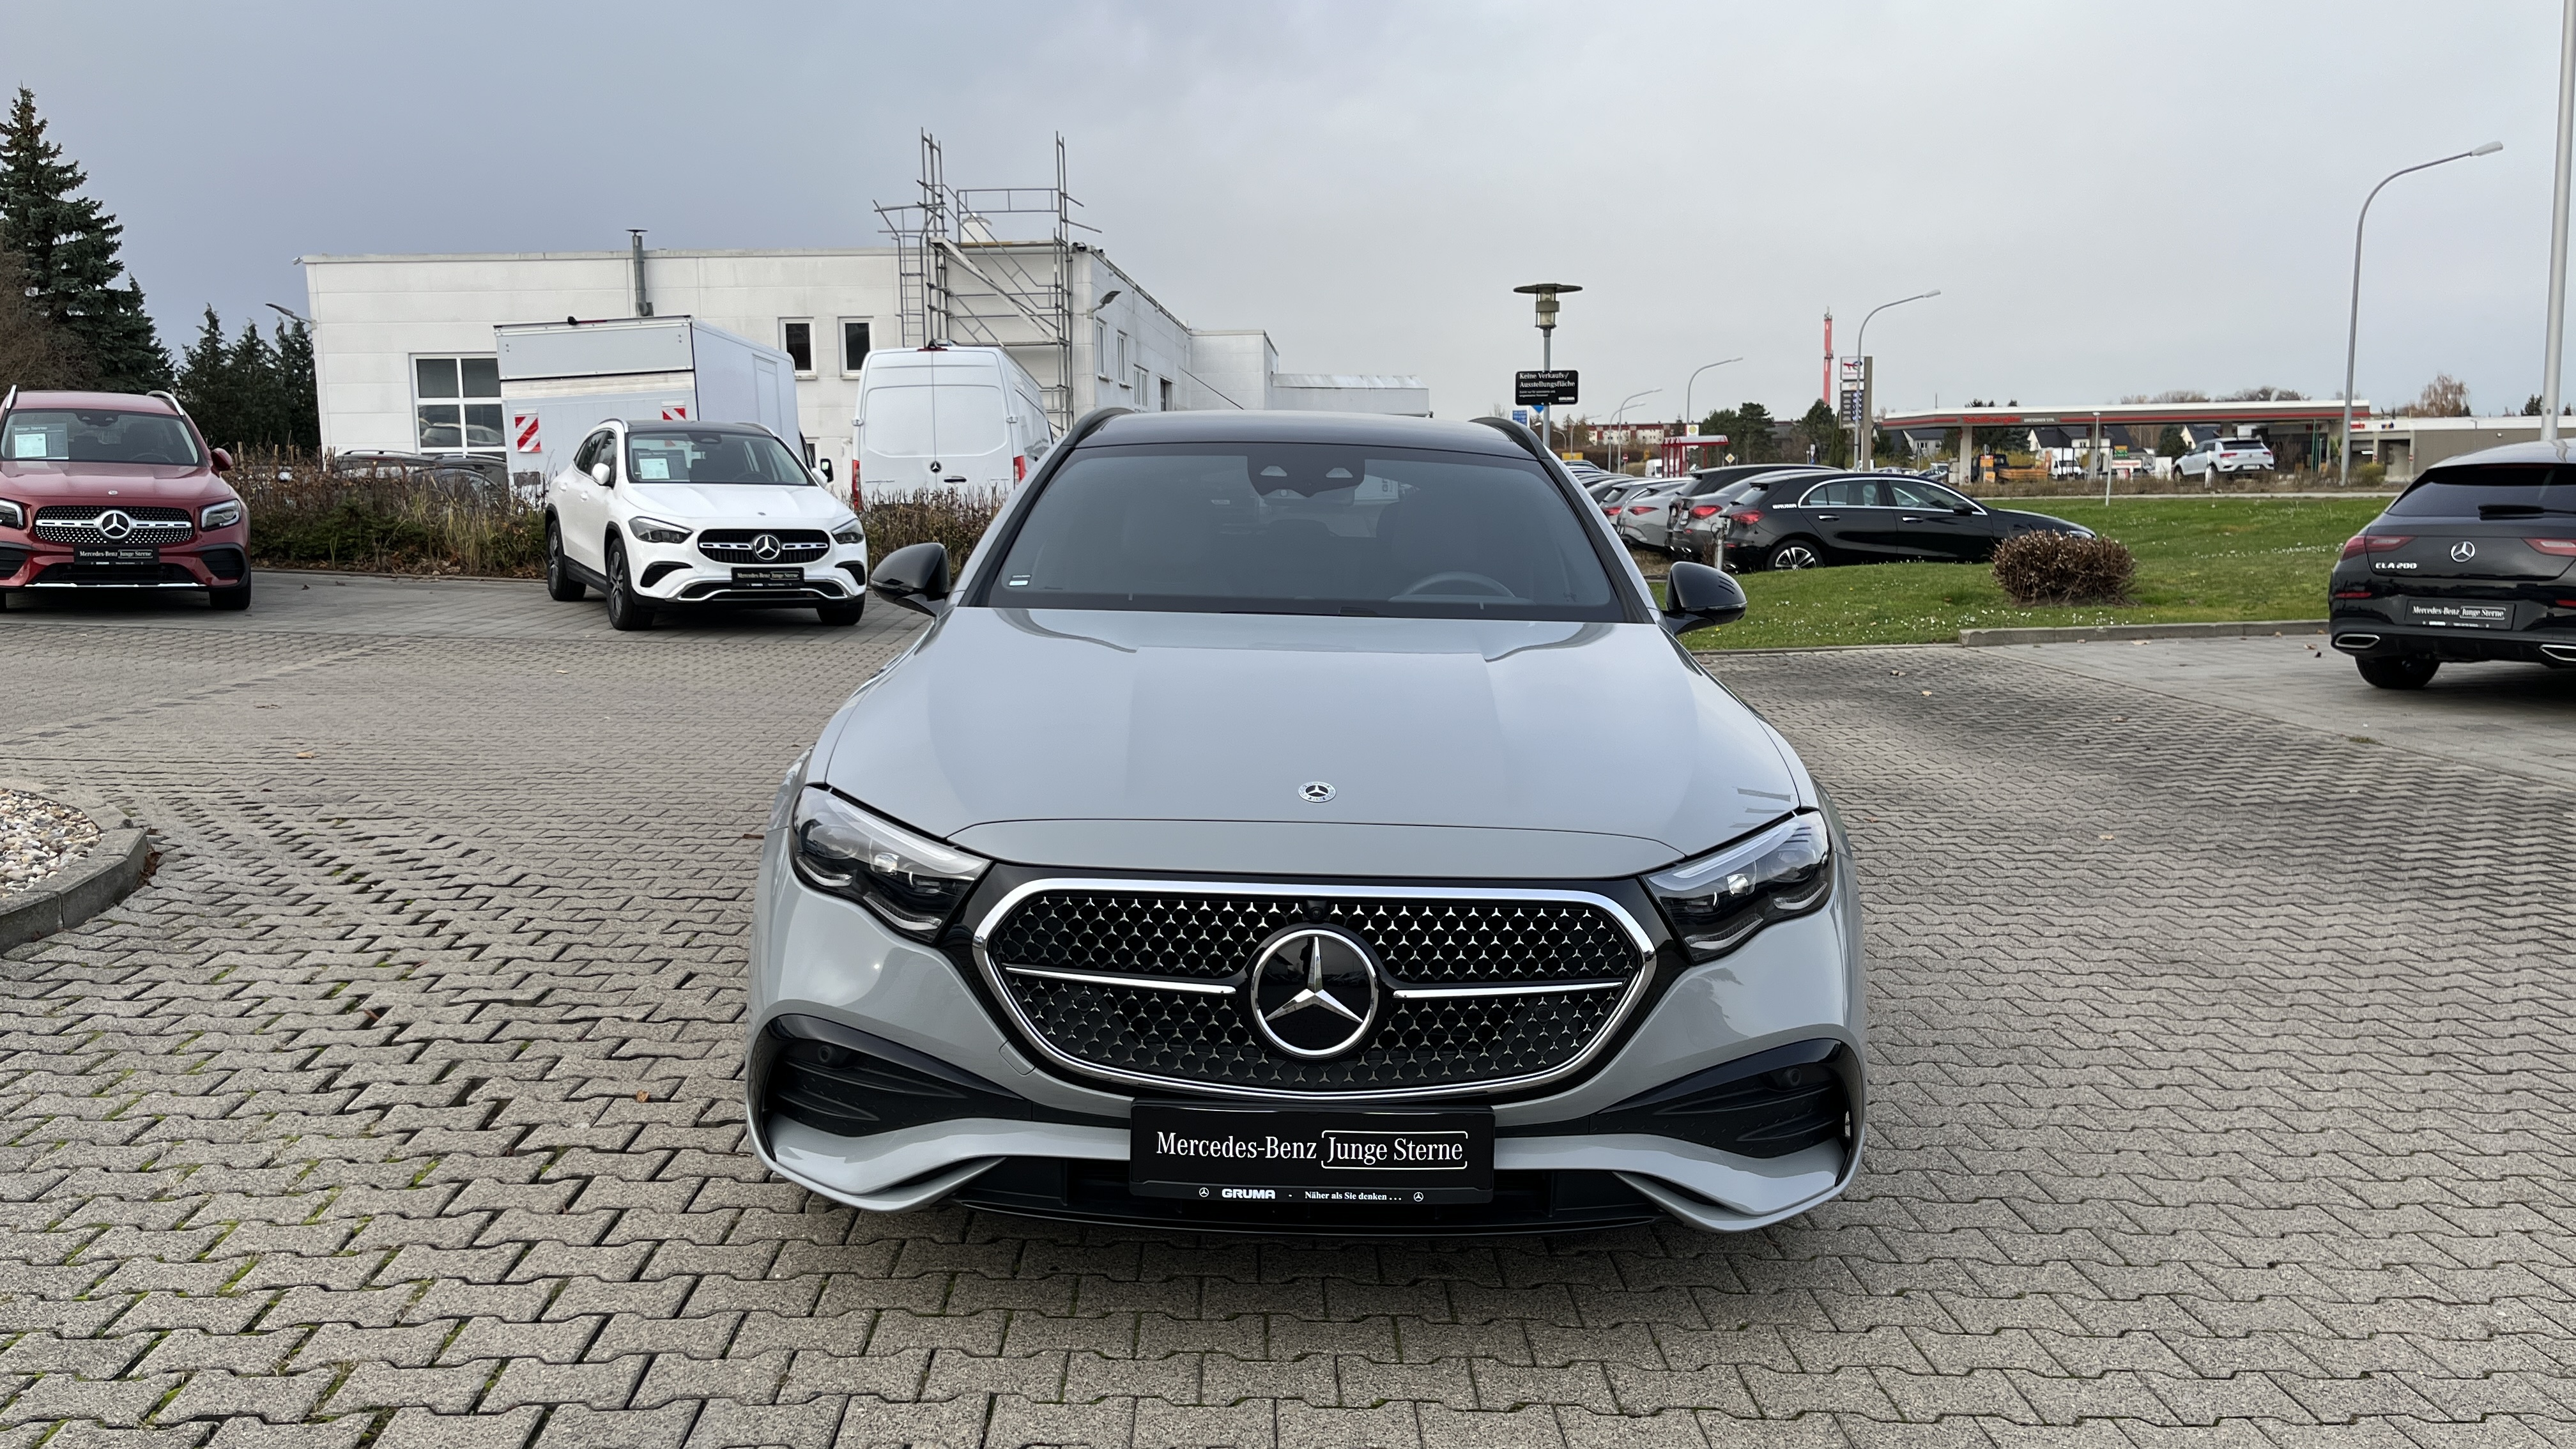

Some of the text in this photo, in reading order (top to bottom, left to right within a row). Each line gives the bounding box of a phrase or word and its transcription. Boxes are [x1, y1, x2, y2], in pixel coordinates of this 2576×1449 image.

[1519, 380, 1575, 389] Ausstellungsfläche
[2412, 606, 2504, 618] Mercedes-Benz Junge Sterne
[1156, 1131, 1463, 1165] Mercedes-Benz Junge Sterne
[1222, 1188, 1276, 1200] GRUMA
[1305, 1191, 1330, 1200] Näher
[1331, 1192, 1343, 1200] als
[1344, 1192, 1357, 1200] Sie
[1358, 1192, 1387, 1201] denken
